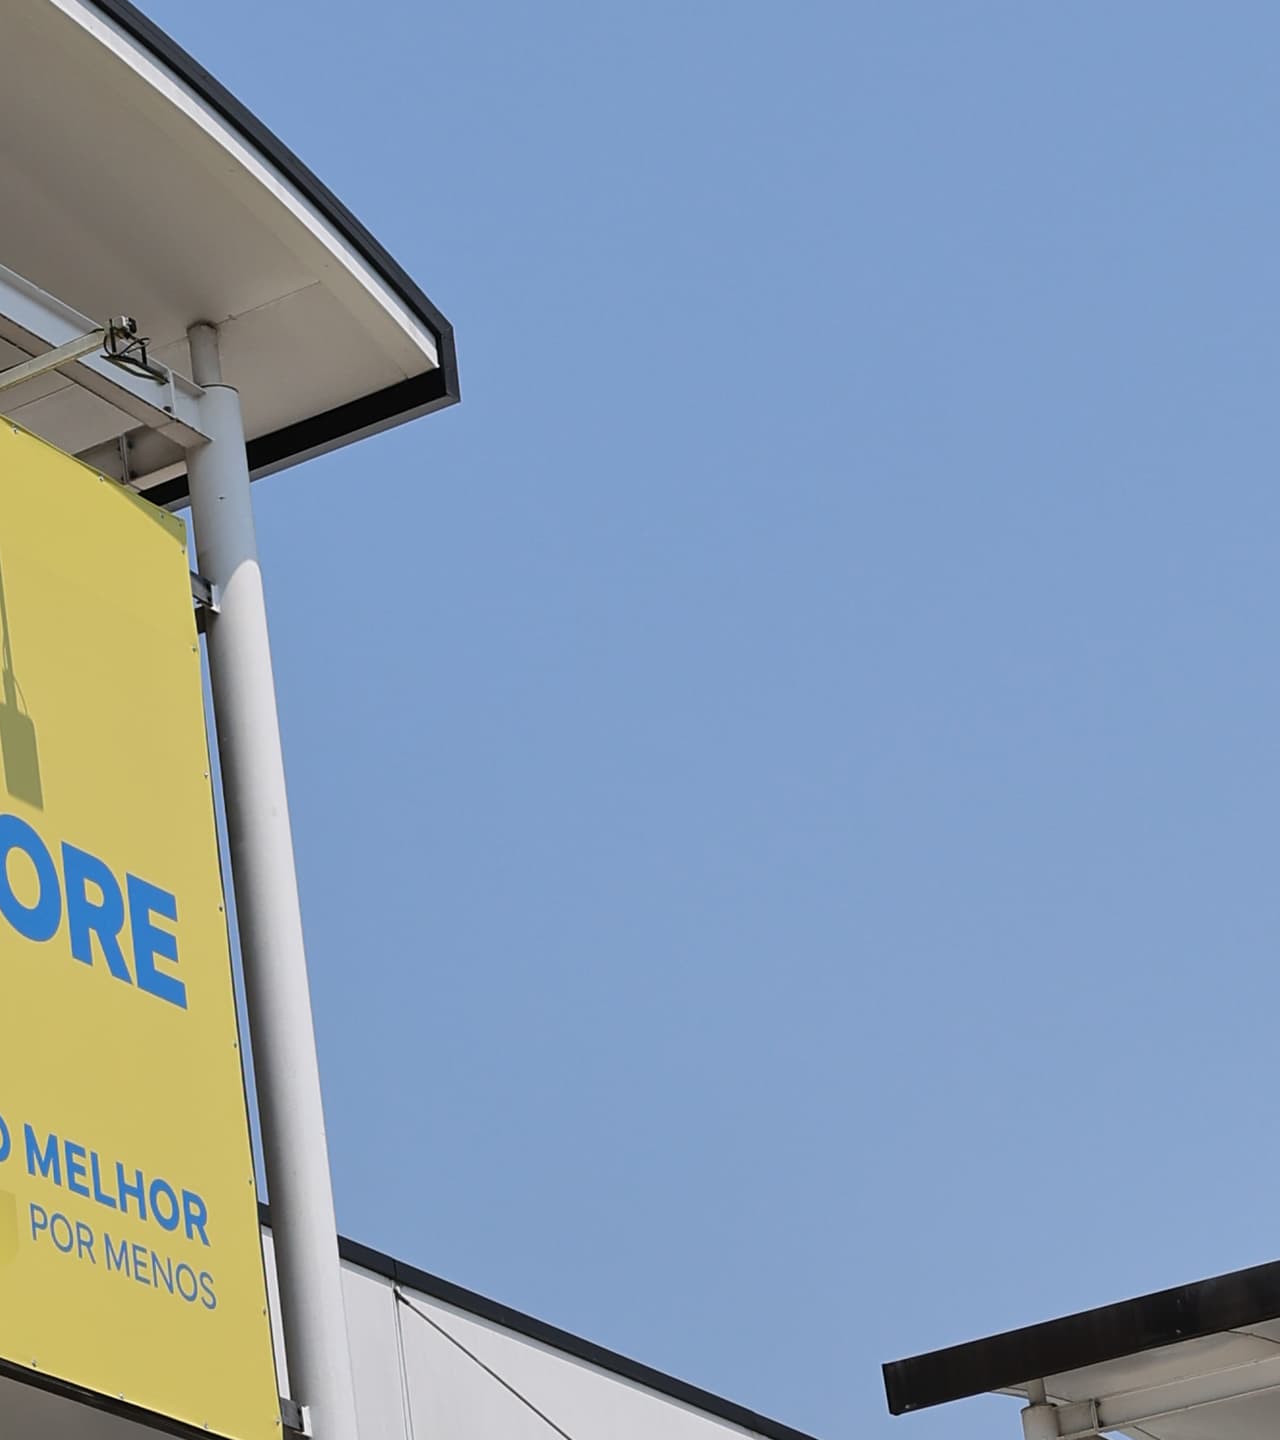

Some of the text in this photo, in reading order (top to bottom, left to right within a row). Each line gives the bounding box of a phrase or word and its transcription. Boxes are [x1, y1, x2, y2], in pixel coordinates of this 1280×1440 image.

[24, 1122, 210, 1247] MELHOR
[29, 1202, 217, 1310] POR MENOS
